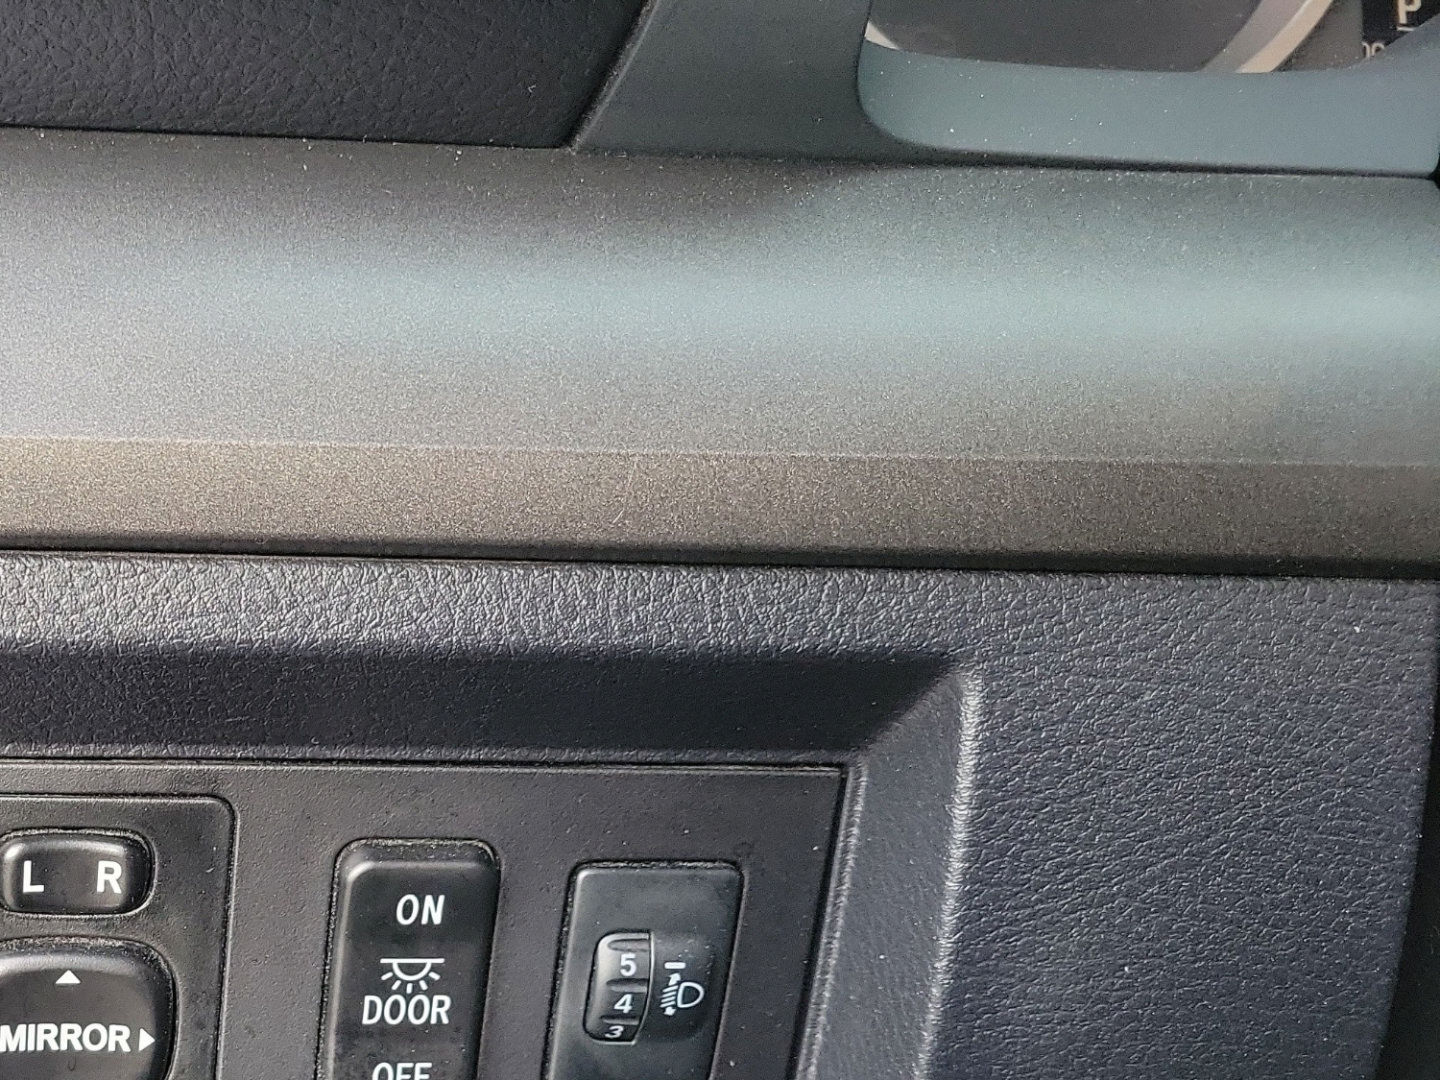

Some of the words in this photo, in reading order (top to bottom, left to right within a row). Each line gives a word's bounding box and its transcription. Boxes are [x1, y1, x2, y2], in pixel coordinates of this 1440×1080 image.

[22, 861, 45, 893] L
[97, 861, 122, 893] R
[397, 895, 444, 925] ON
[620, 953, 637, 976] 5
[362, 995, 451, 1025] DOOR
[614, 994, 633, 1014] 4
[0, 1023, 130, 1053] MIRROR
[605, 1025, 624, 1038] 3
